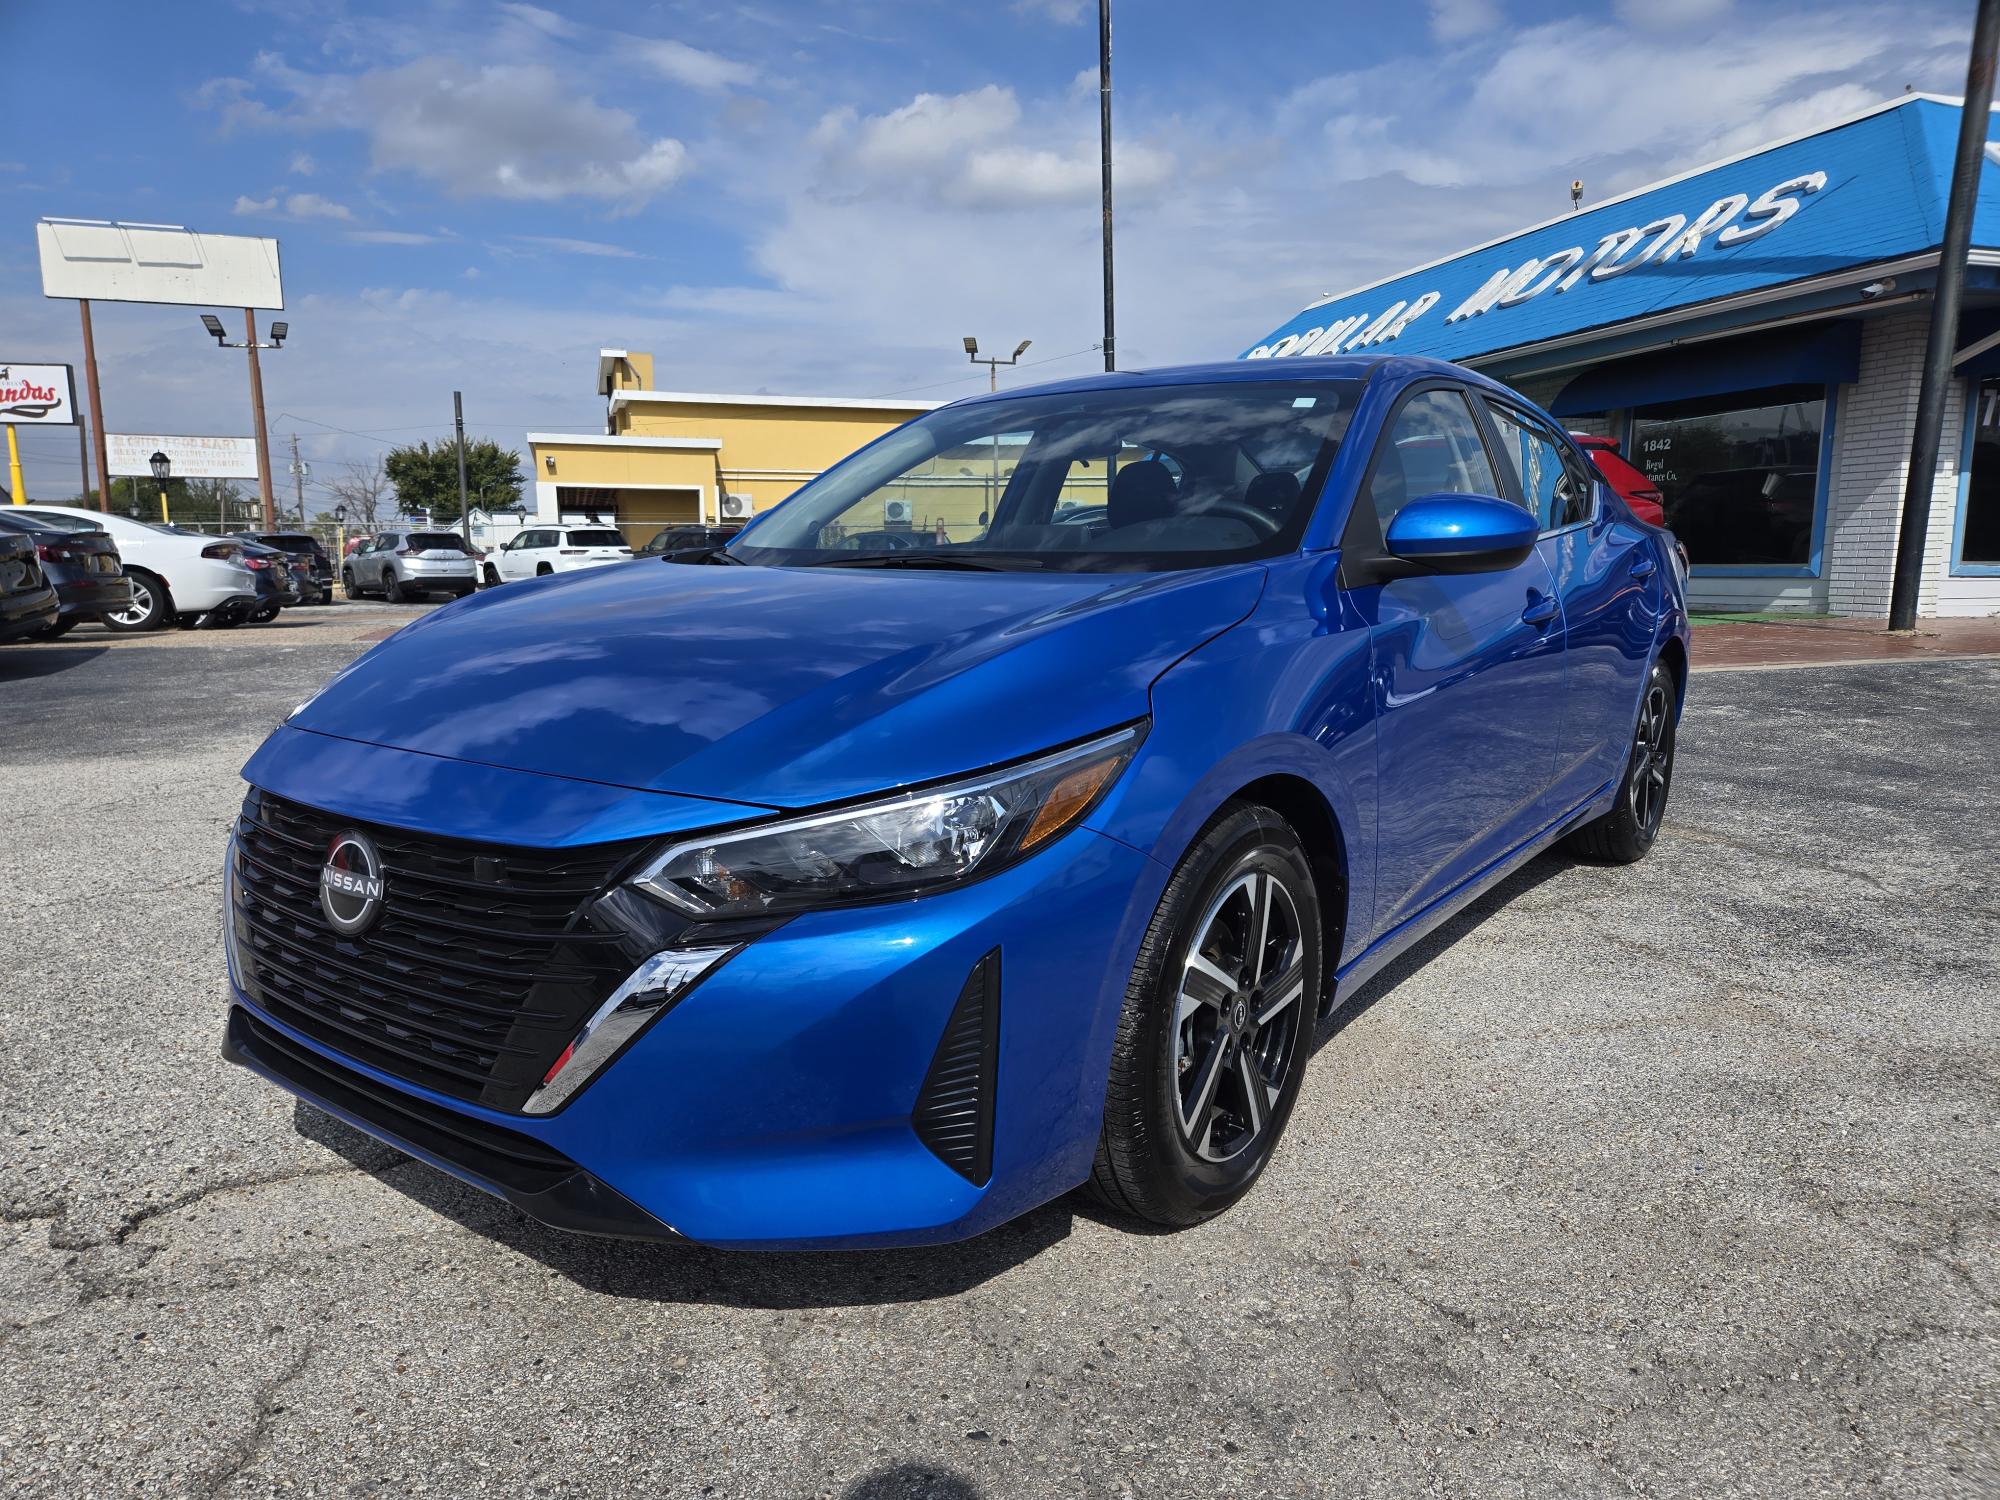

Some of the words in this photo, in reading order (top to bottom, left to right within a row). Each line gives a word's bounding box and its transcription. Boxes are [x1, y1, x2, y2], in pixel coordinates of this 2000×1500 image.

[1444, 170, 1828, 325] MOTORS
[0, 379, 56, 403] ndas
[1643, 438, 1672, 452] 1842
[1646, 458, 1664, 472] Regal
[322, 867, 381, 897] NISSAN
